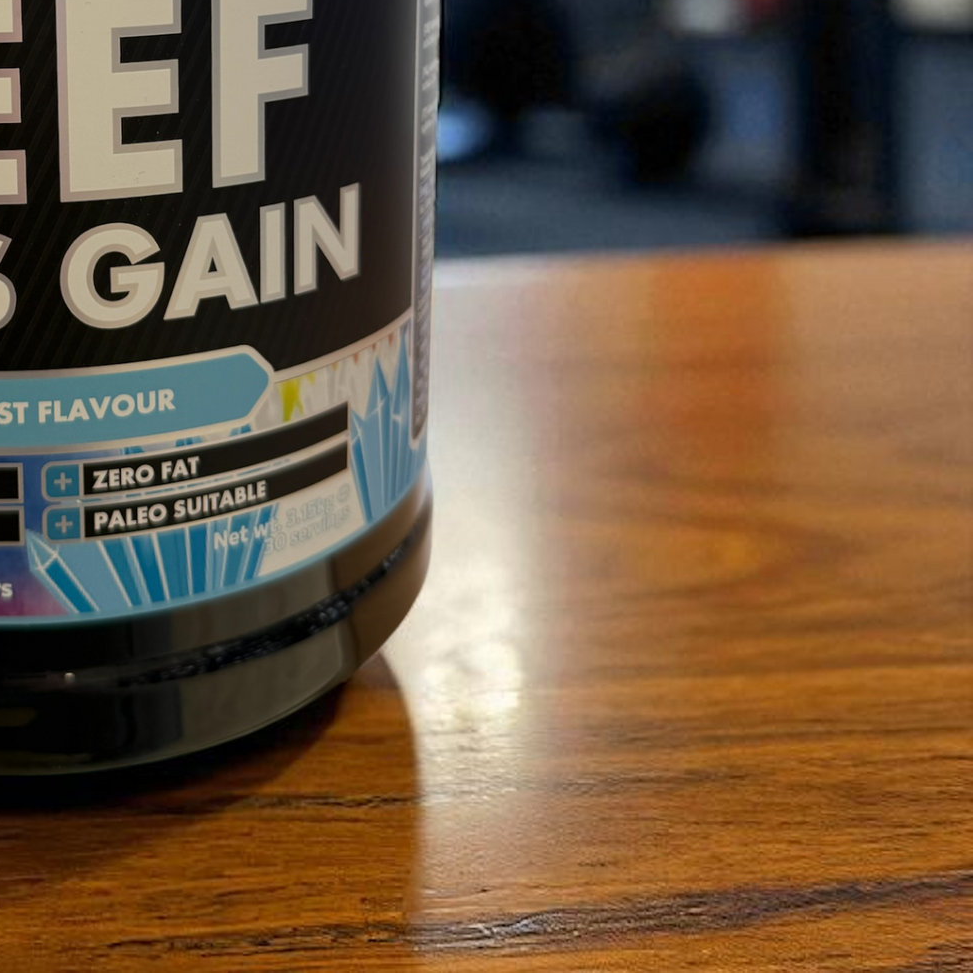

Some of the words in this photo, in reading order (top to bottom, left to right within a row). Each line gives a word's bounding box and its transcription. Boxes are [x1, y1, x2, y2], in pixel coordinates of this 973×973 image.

[59, 182, 360, 329] GAIN
[38, 388, 176, 424] FLAVOUR
[92, 464, 155, 490] ZERO
[161, 456, 201, 480] FAT
[93, 502, 167, 531] PALEO
[173, 480, 267, 519] SUITABLE
[214, 525, 248, 550] Net
